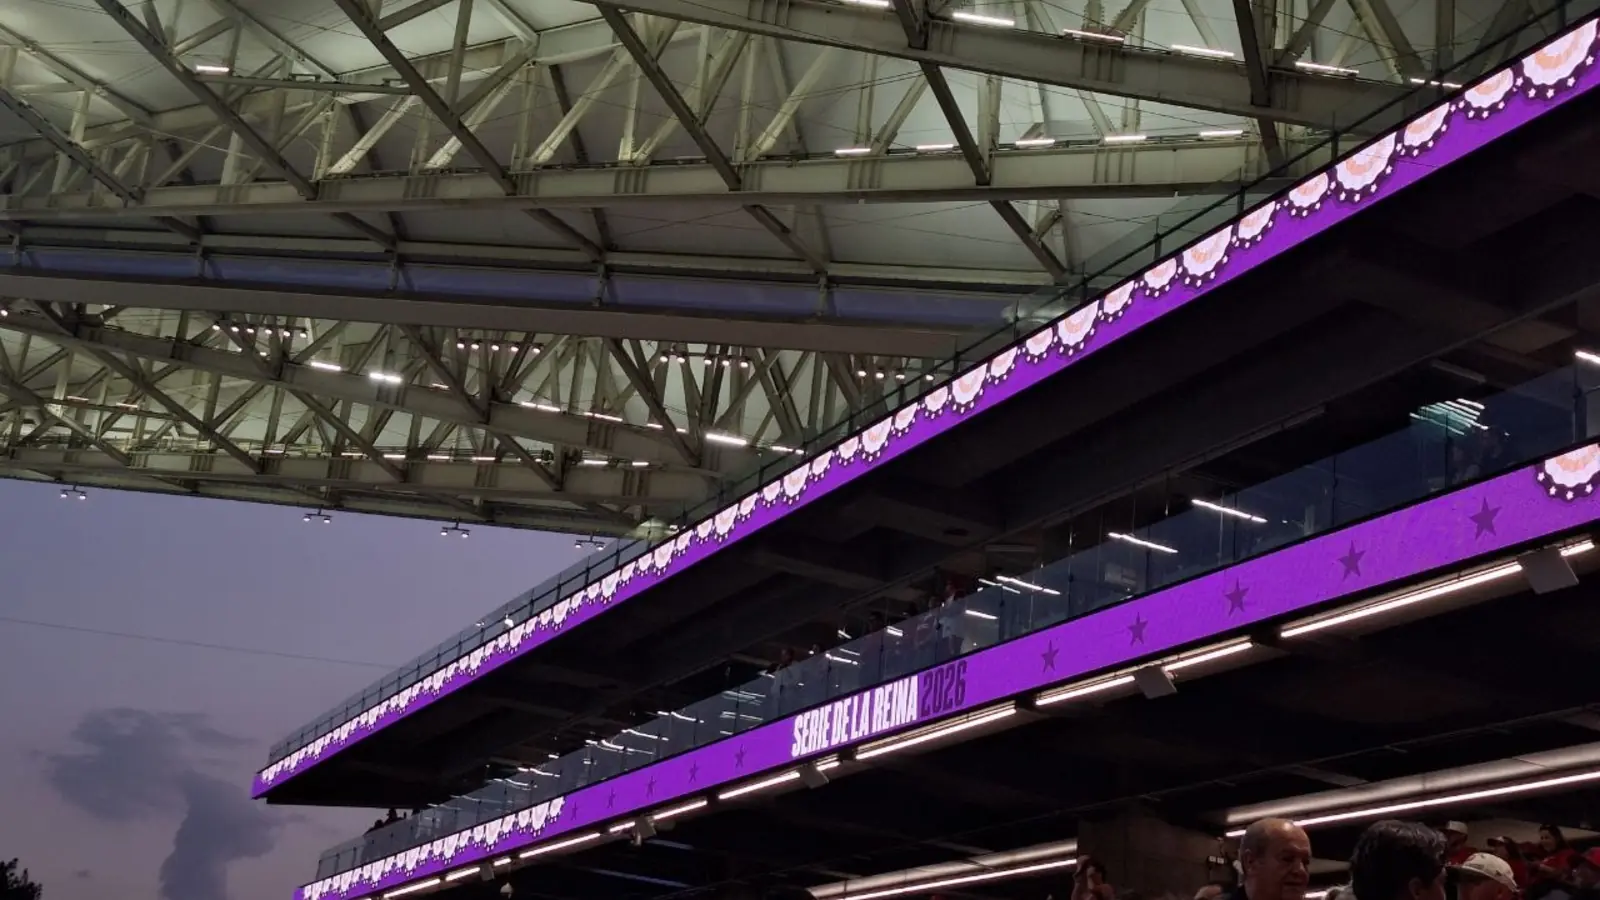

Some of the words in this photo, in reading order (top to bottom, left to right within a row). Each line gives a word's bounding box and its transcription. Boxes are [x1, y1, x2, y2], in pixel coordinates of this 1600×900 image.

[792, 704, 832, 757] SERIE
[831, 698, 850, 746] DE
[851, 691, 871, 739] LA
[872, 675, 918, 733] REINA
[920, 660, 967, 716] 2026
